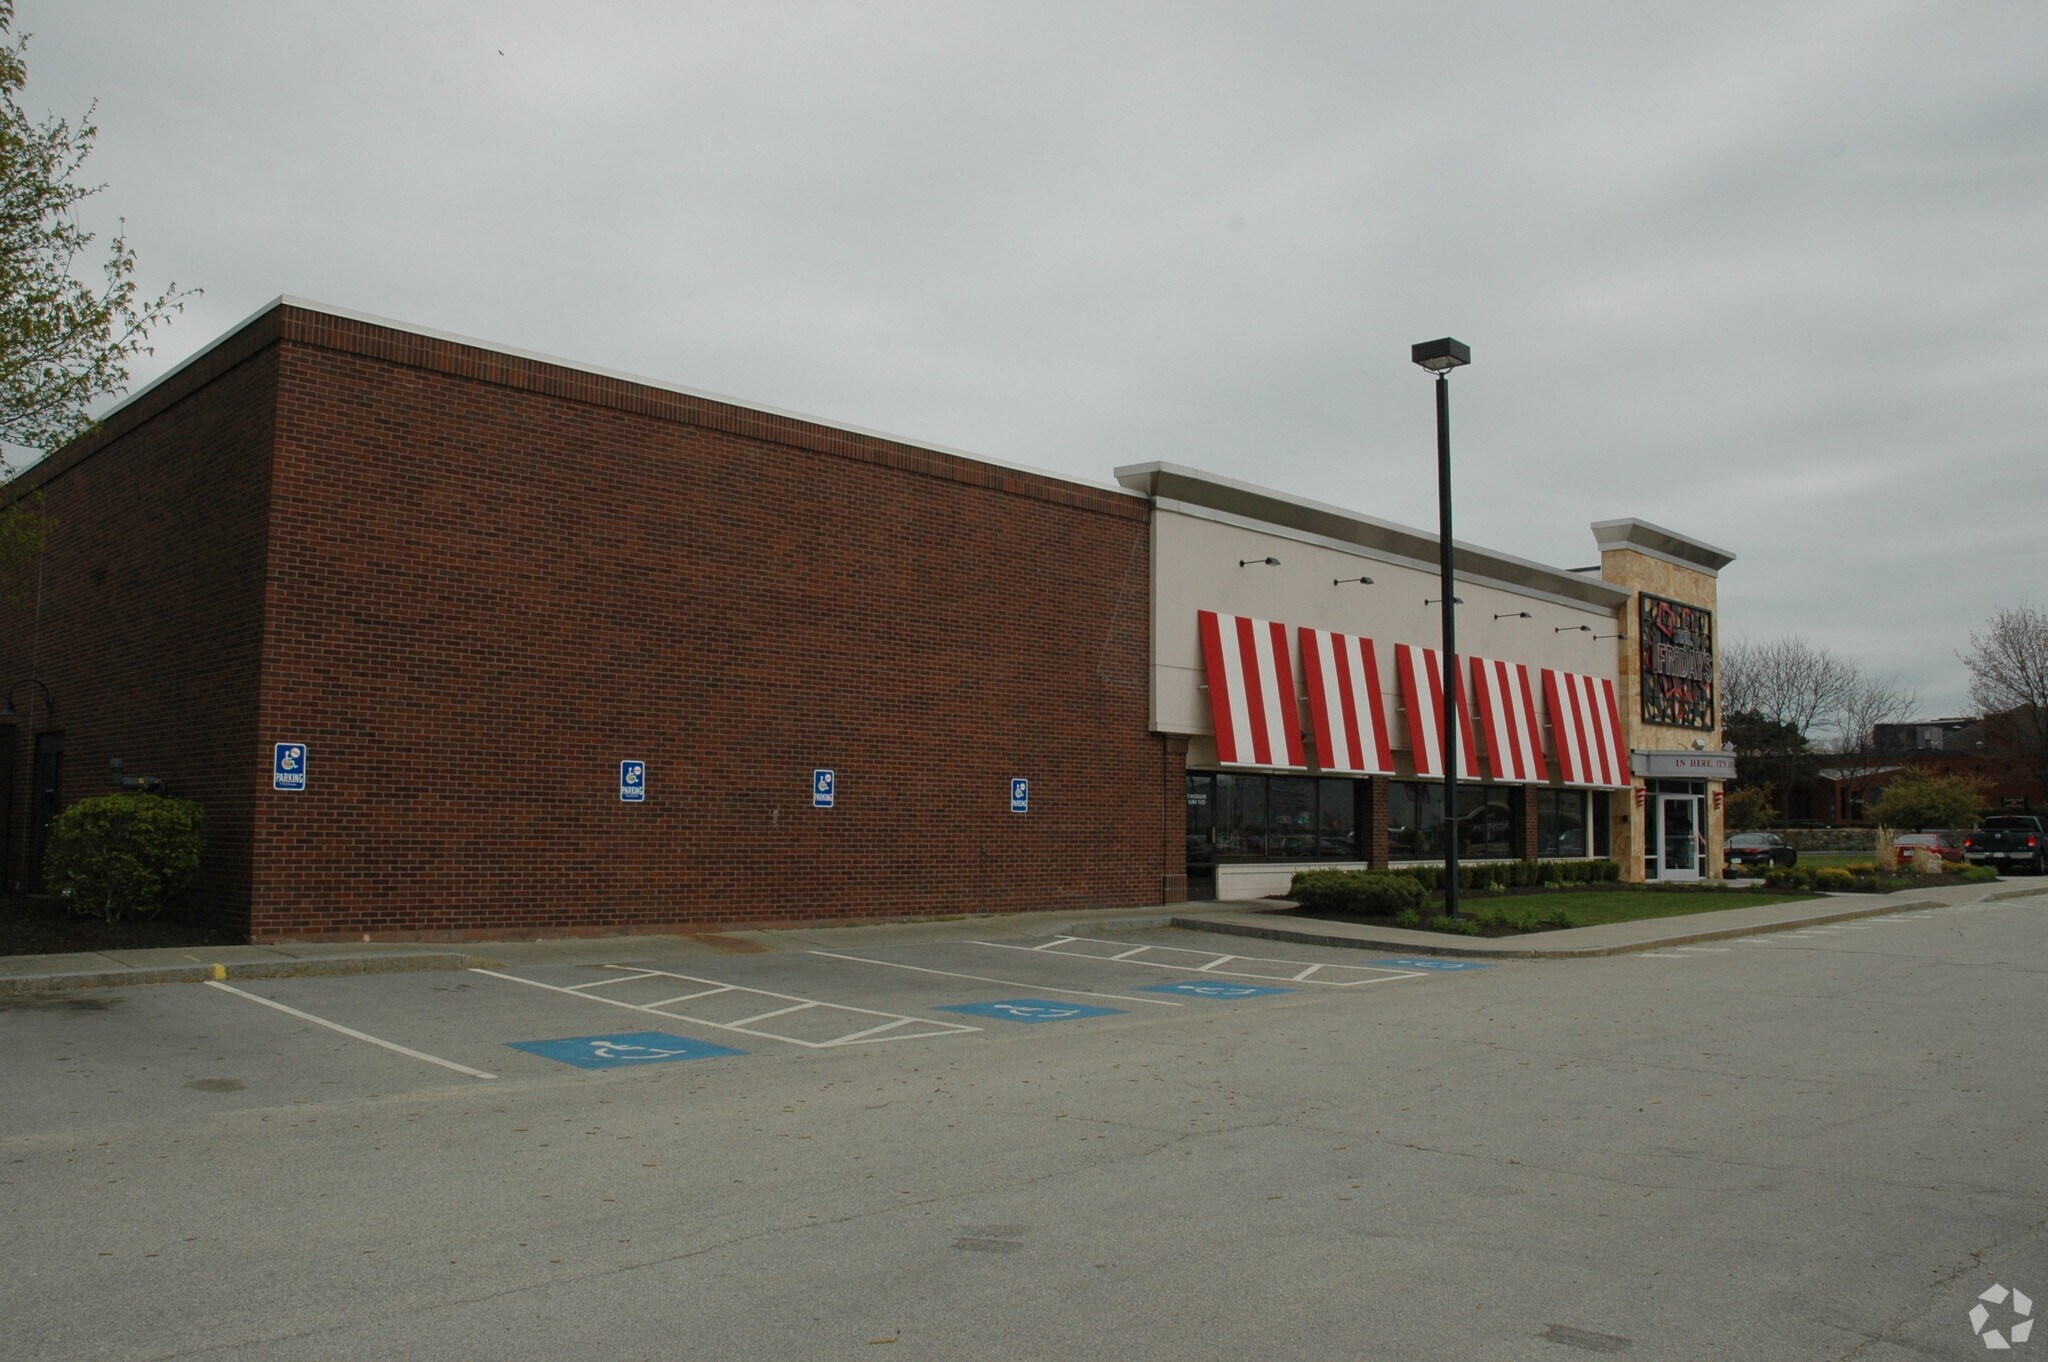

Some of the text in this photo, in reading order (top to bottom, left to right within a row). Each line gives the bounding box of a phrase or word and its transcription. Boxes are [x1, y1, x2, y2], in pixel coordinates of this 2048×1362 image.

[1675, 759, 1686, 767] IN
[275, 772, 304, 784] PARKING
[621, 786, 643, 796] PARKING
[814, 793, 833, 802] PARKING
